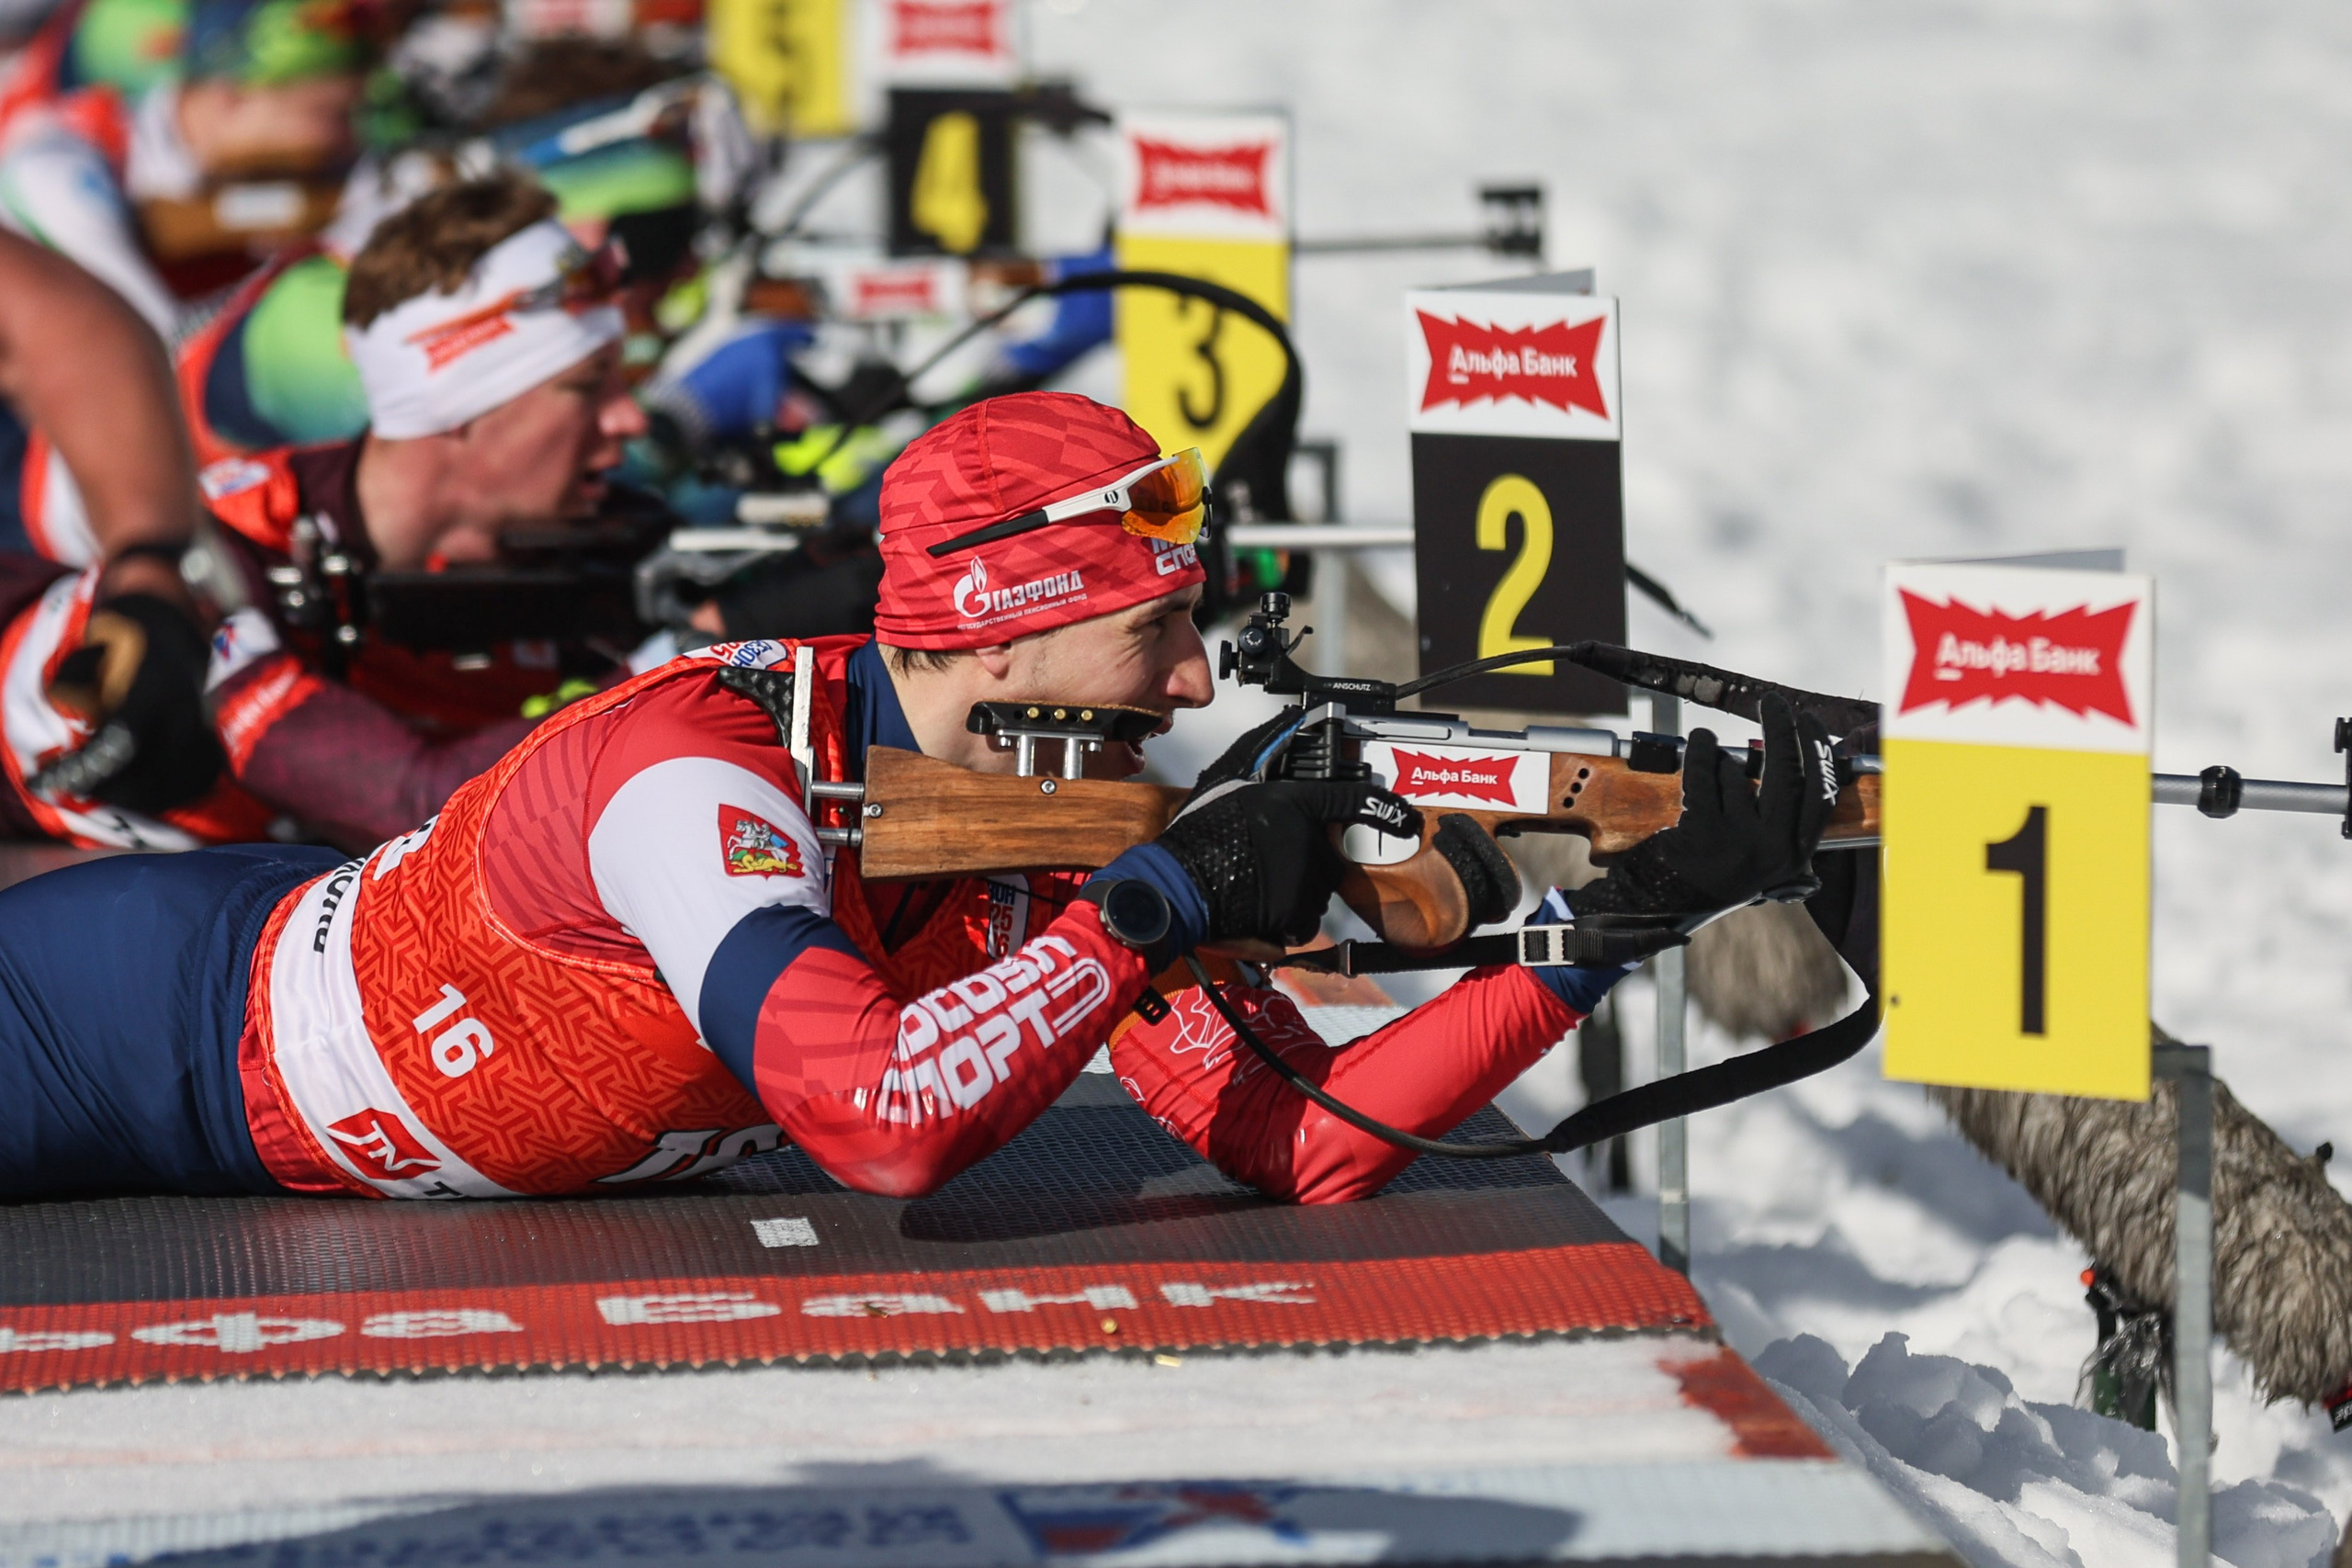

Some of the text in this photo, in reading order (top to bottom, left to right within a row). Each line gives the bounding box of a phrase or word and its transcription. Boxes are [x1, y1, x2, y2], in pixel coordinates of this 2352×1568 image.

[911, 110, 988, 254] 4
[1177, 294, 1224, 429] 3
[1449, 344, 1578, 384] Альфа Банк
[992, 570, 1085, 612] ГАЗФОНД
[1476, 474, 1554, 675] 2
[1023, 598, 1068, 615] ПЕНСИОННЫЙ
[1068, 592, 1088, 604] ФОНД
[1934, 631, 2102, 681] Альфа Банк
[1410, 766, 1498, 785] Альфа Банк
[1984, 805, 2050, 1036] 1
[412, 983, 494, 1078] 16
[596, 1280, 1316, 1325] Банк
